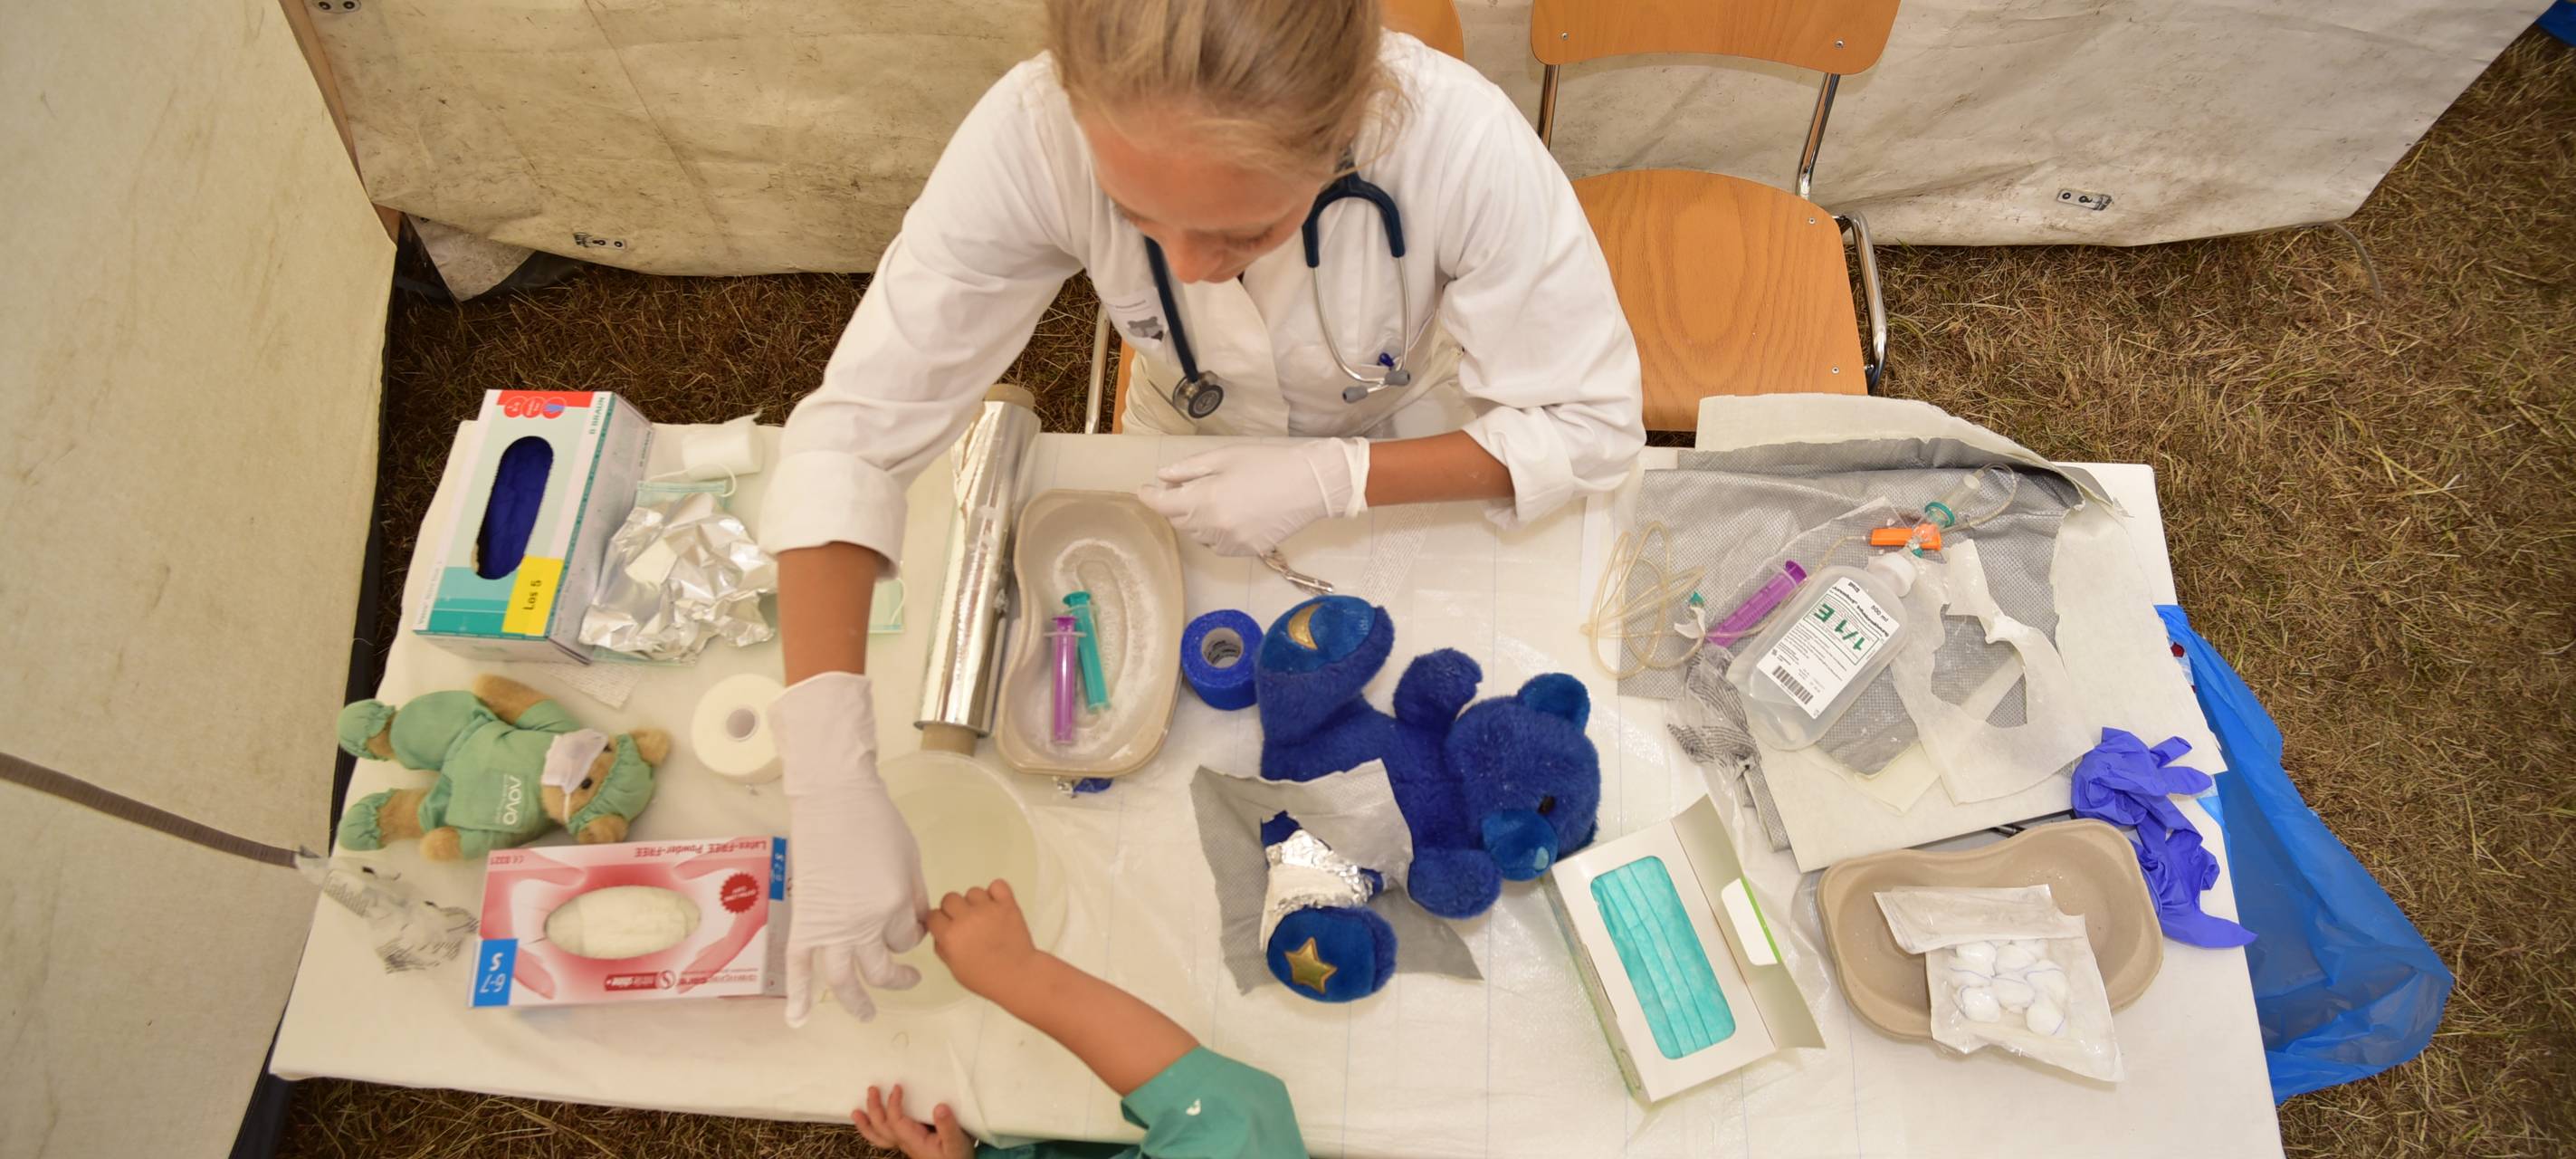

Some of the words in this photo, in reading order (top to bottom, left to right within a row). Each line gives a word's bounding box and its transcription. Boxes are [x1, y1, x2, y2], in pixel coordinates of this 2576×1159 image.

[521, 591, 539, 610] Los
[1814, 603, 1836, 623] E
[1834, 619, 1865, 651] 1/1
[634, 844, 704, 858] Powder-FREE
[707, 840, 768, 854] Latex-FREE
[489, 952, 504, 971] S
[479, 972, 506, 993] 6-7
